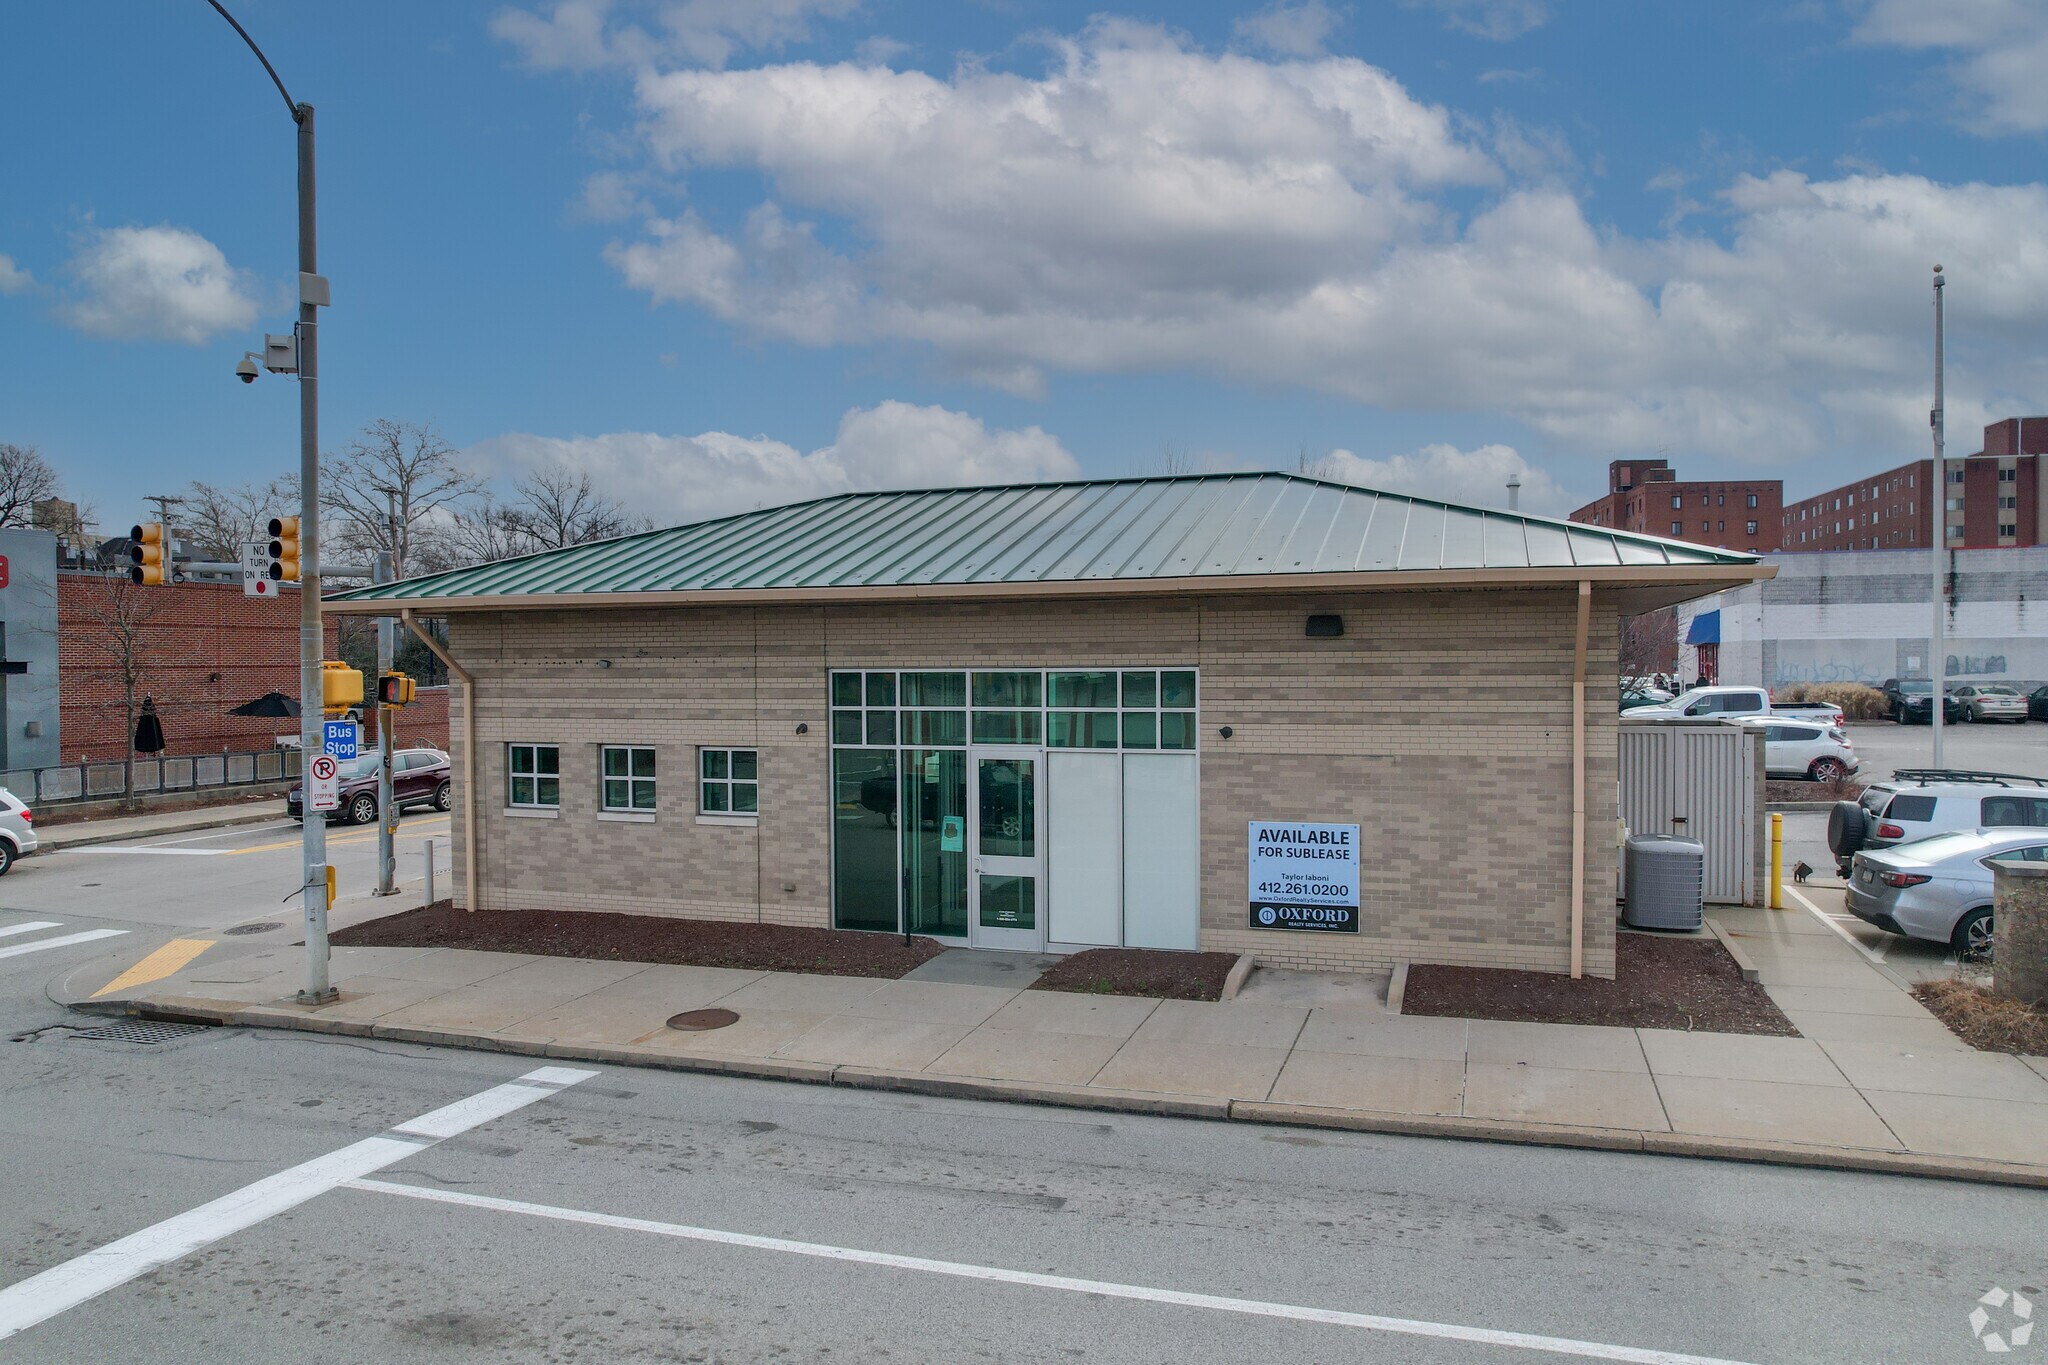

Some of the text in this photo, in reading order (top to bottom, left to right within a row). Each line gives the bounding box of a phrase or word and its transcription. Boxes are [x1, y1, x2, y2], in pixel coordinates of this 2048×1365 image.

[254, 546, 264, 555] NO
[250, 559, 269, 567] TURN
[245, 571, 270, 579] ON RE
[328, 725, 352, 738] Bus
[326, 741, 355, 755] Stop
[1258, 829, 1350, 845] AVAILABLE
[1258, 846, 1350, 860] FOR SUBLEASE
[1281, 873, 1304, 882] Taylor
[1258, 882, 1349, 897] 412.261.0200
[1258, 896, 1349, 904] www.OxfordRealtyServices.com
[1278, 907, 1349, 922] OXFORD
